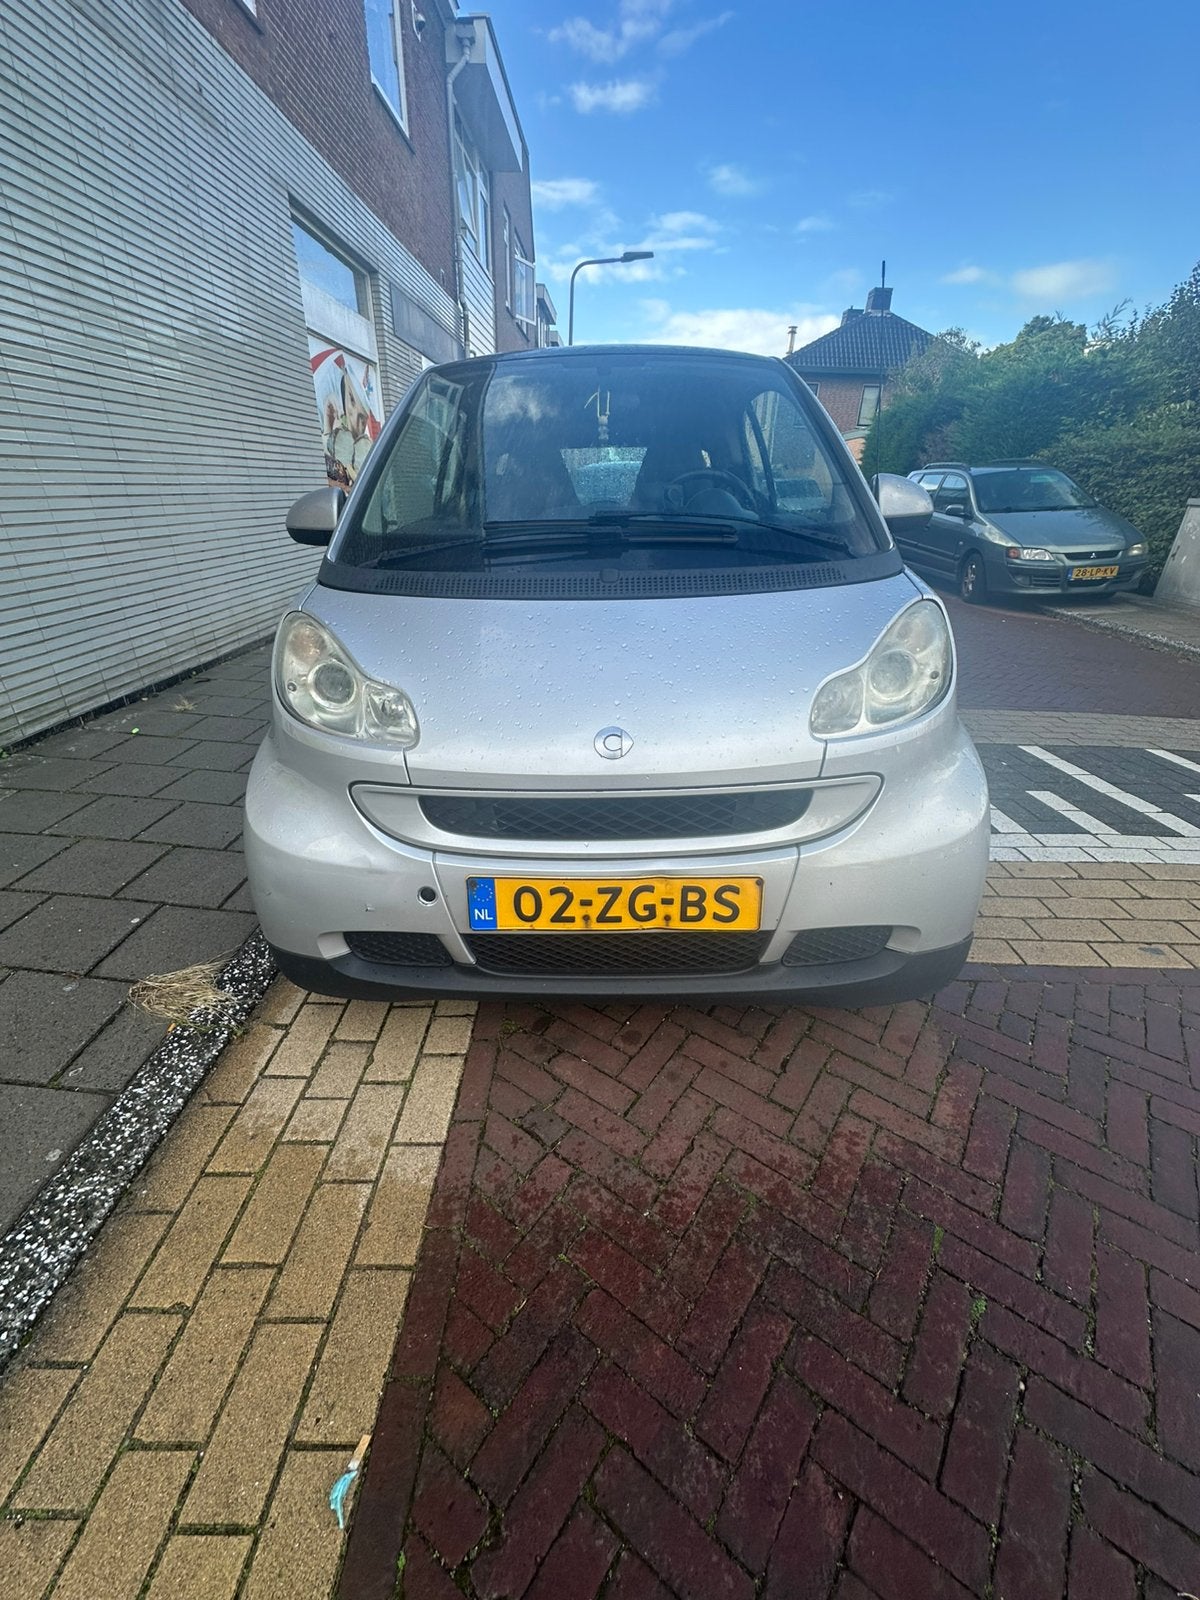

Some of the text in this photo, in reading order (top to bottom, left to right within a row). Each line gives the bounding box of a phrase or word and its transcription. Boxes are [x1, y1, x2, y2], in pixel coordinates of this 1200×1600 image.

[1075, 567, 1116, 577] 28-LP-KV
[513, 885, 741, 923] 02-ZG-BS
[474, 908, 493, 921] NL
